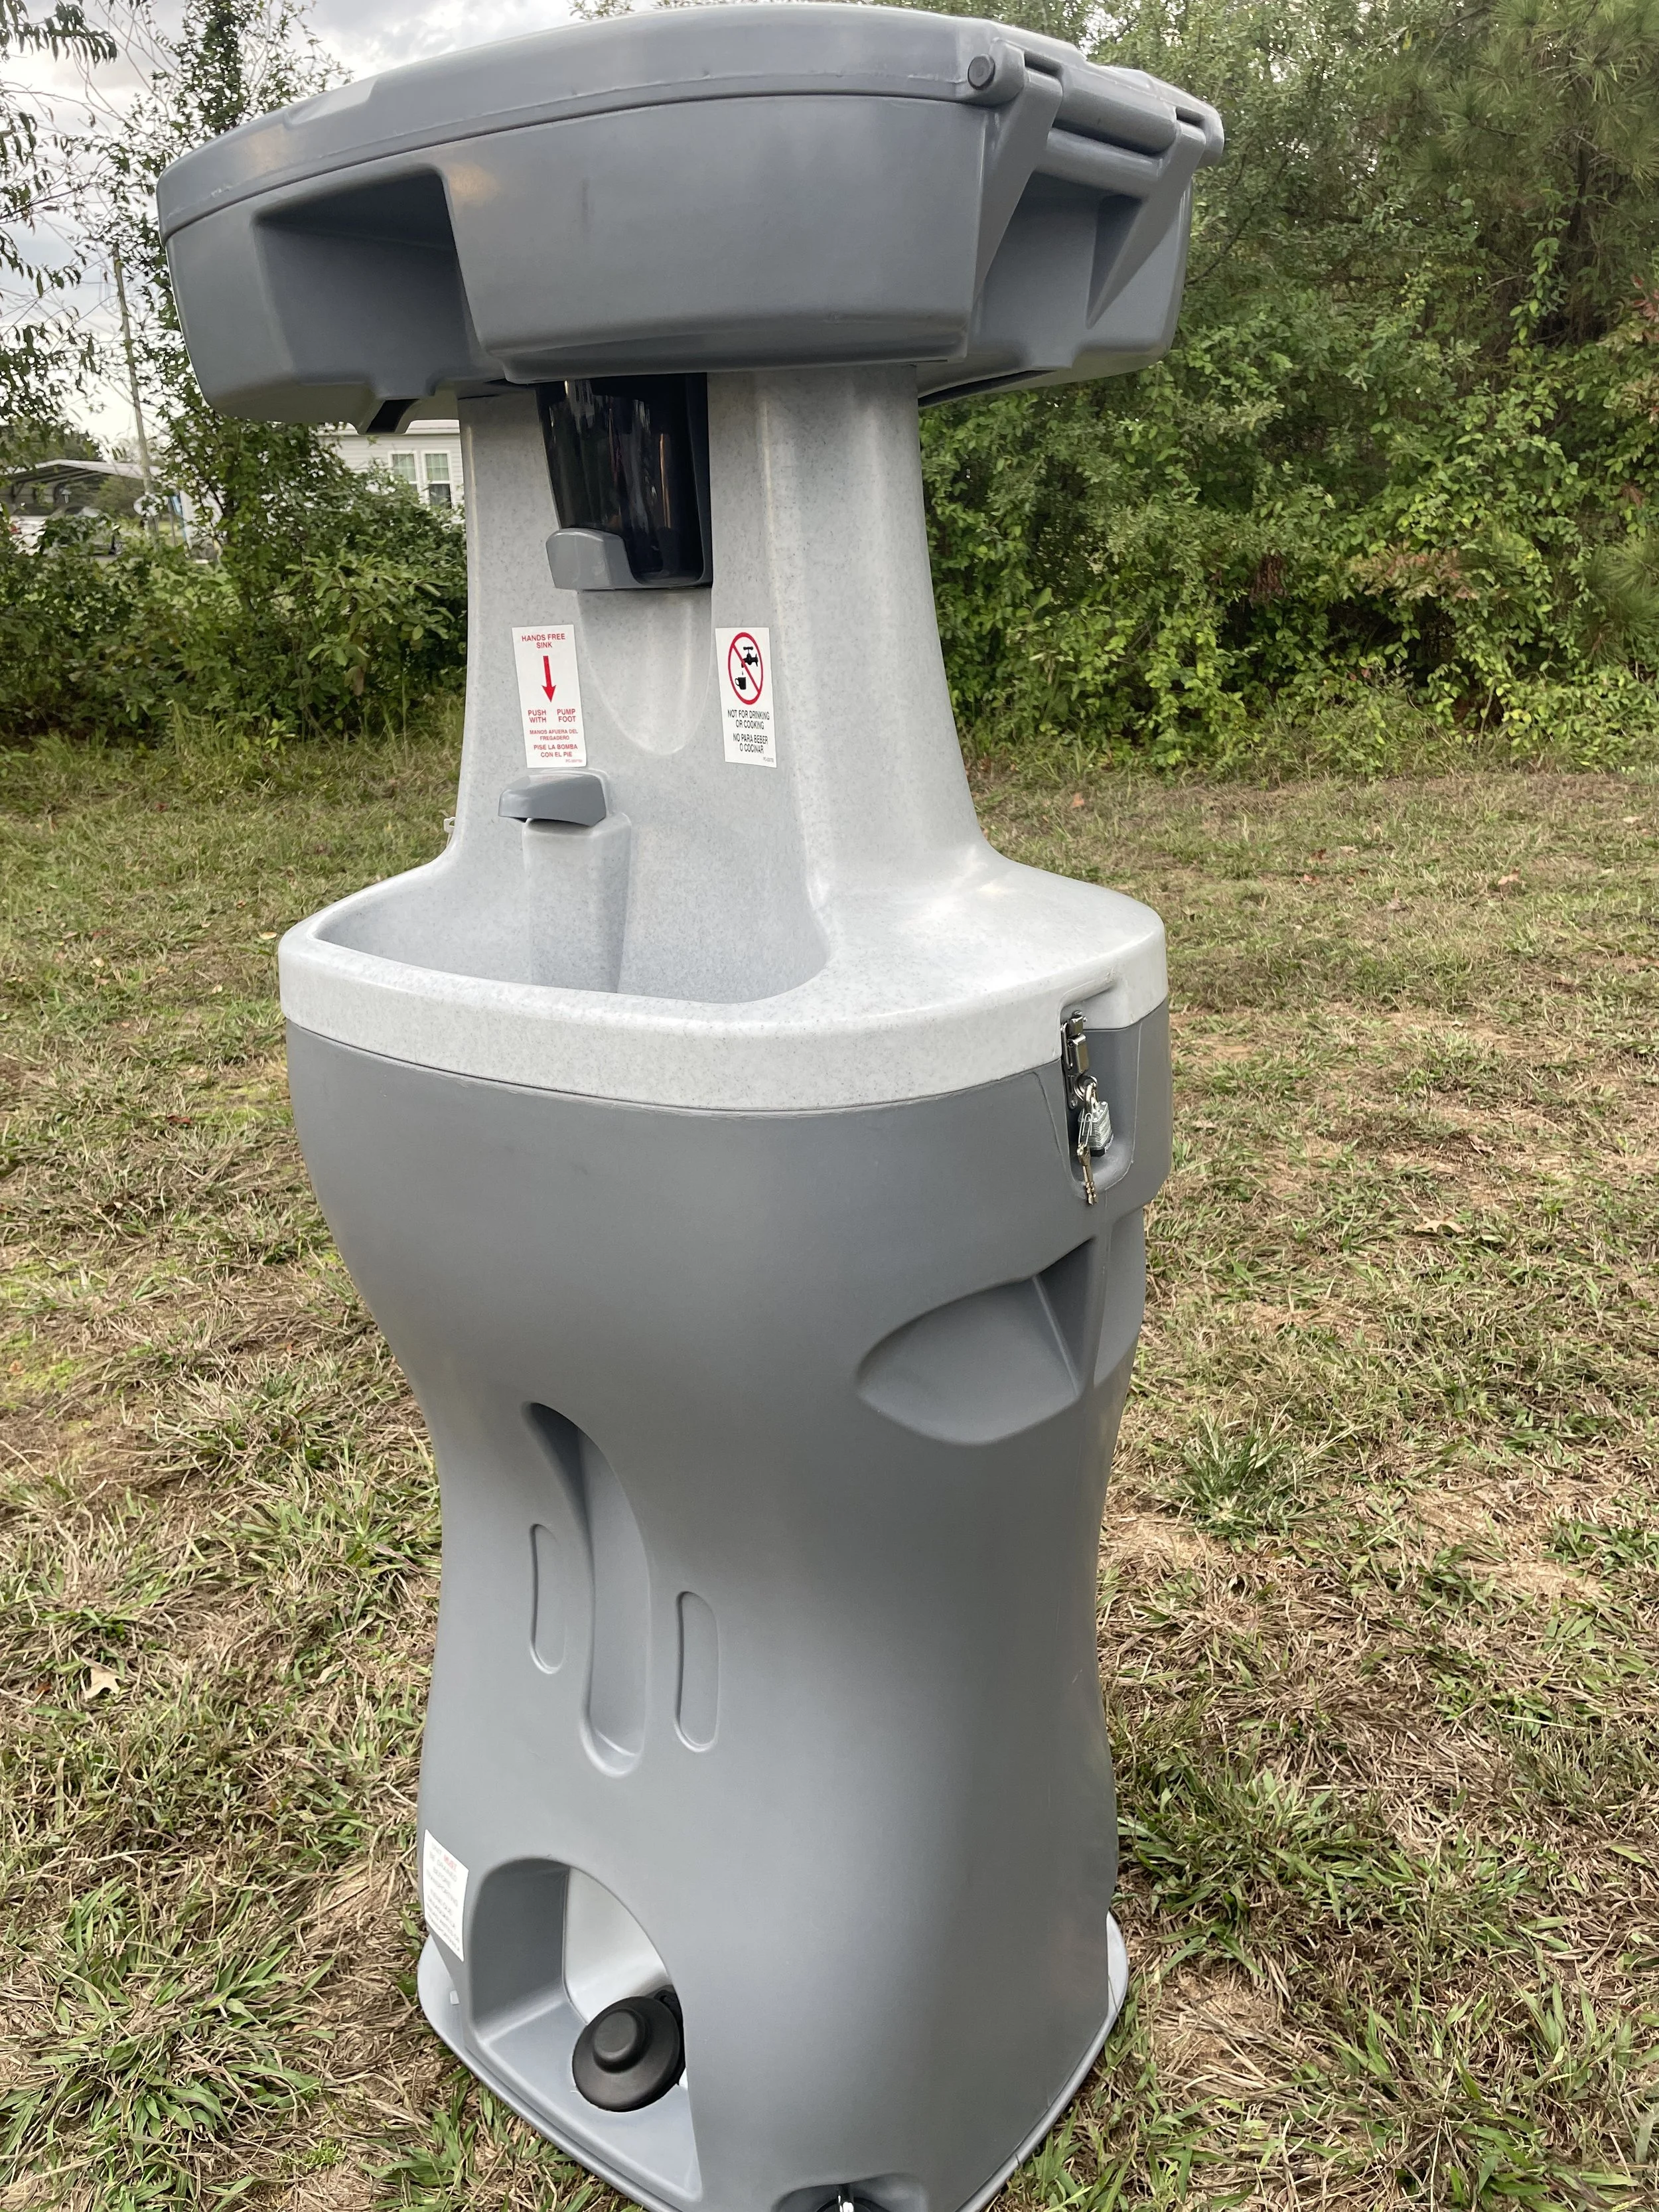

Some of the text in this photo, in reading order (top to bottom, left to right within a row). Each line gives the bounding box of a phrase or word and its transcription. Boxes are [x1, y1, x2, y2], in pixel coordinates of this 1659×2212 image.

[749, 710, 770, 720] DRINKING
[744, 720, 764, 729] COOKING
[733, 733, 768, 745] NO PARA BEBER
[744, 743, 764, 753] COCINAR
